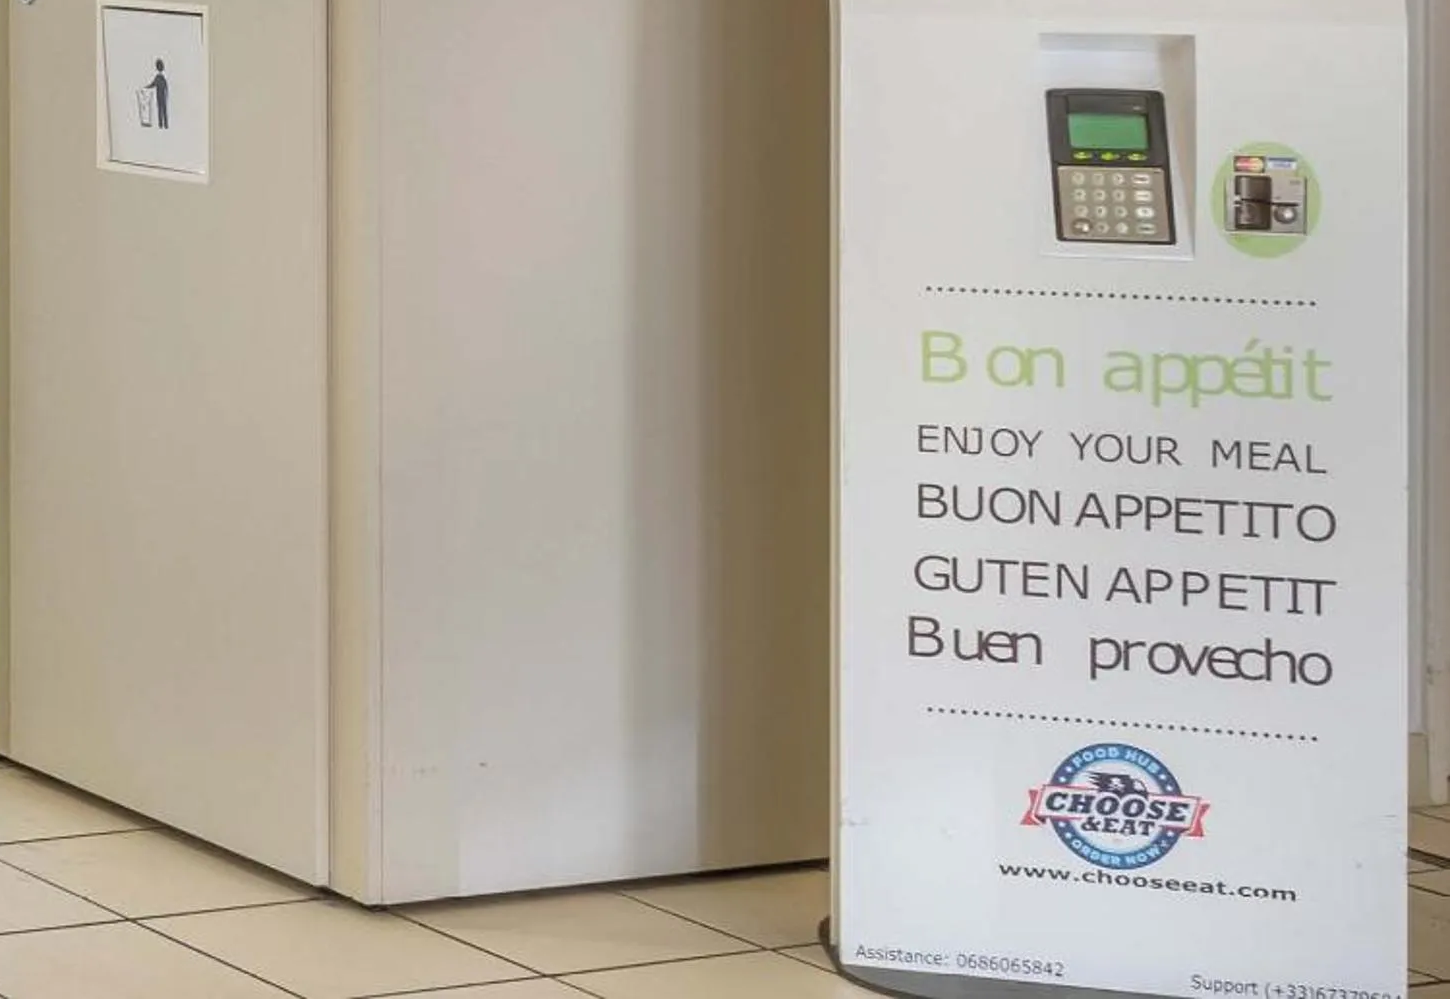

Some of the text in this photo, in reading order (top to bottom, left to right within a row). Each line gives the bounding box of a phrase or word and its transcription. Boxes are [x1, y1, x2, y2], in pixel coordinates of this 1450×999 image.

[1102, 337, 1334, 409] appétit
[916, 424, 1328, 474] ENJOY YOUR MEAL
[916, 483, 1337, 543] BUON APPETITO
[913, 554, 1338, 616] GUTEN APPETIT
[907, 615, 1334, 687] Buen provecho
[1072, 746, 1162, 774] FOOD HUB
[1045, 791, 1190, 823] CHOOSE
[1081, 816, 1155, 836] &EAT
[1071, 838, 1121, 867] ORDER
[999, 863, 1297, 902] www.chooseeat.com
[855, 944, 1065, 977] Assistance: 0686065842
[1190, 974, 1258, 996] Support
